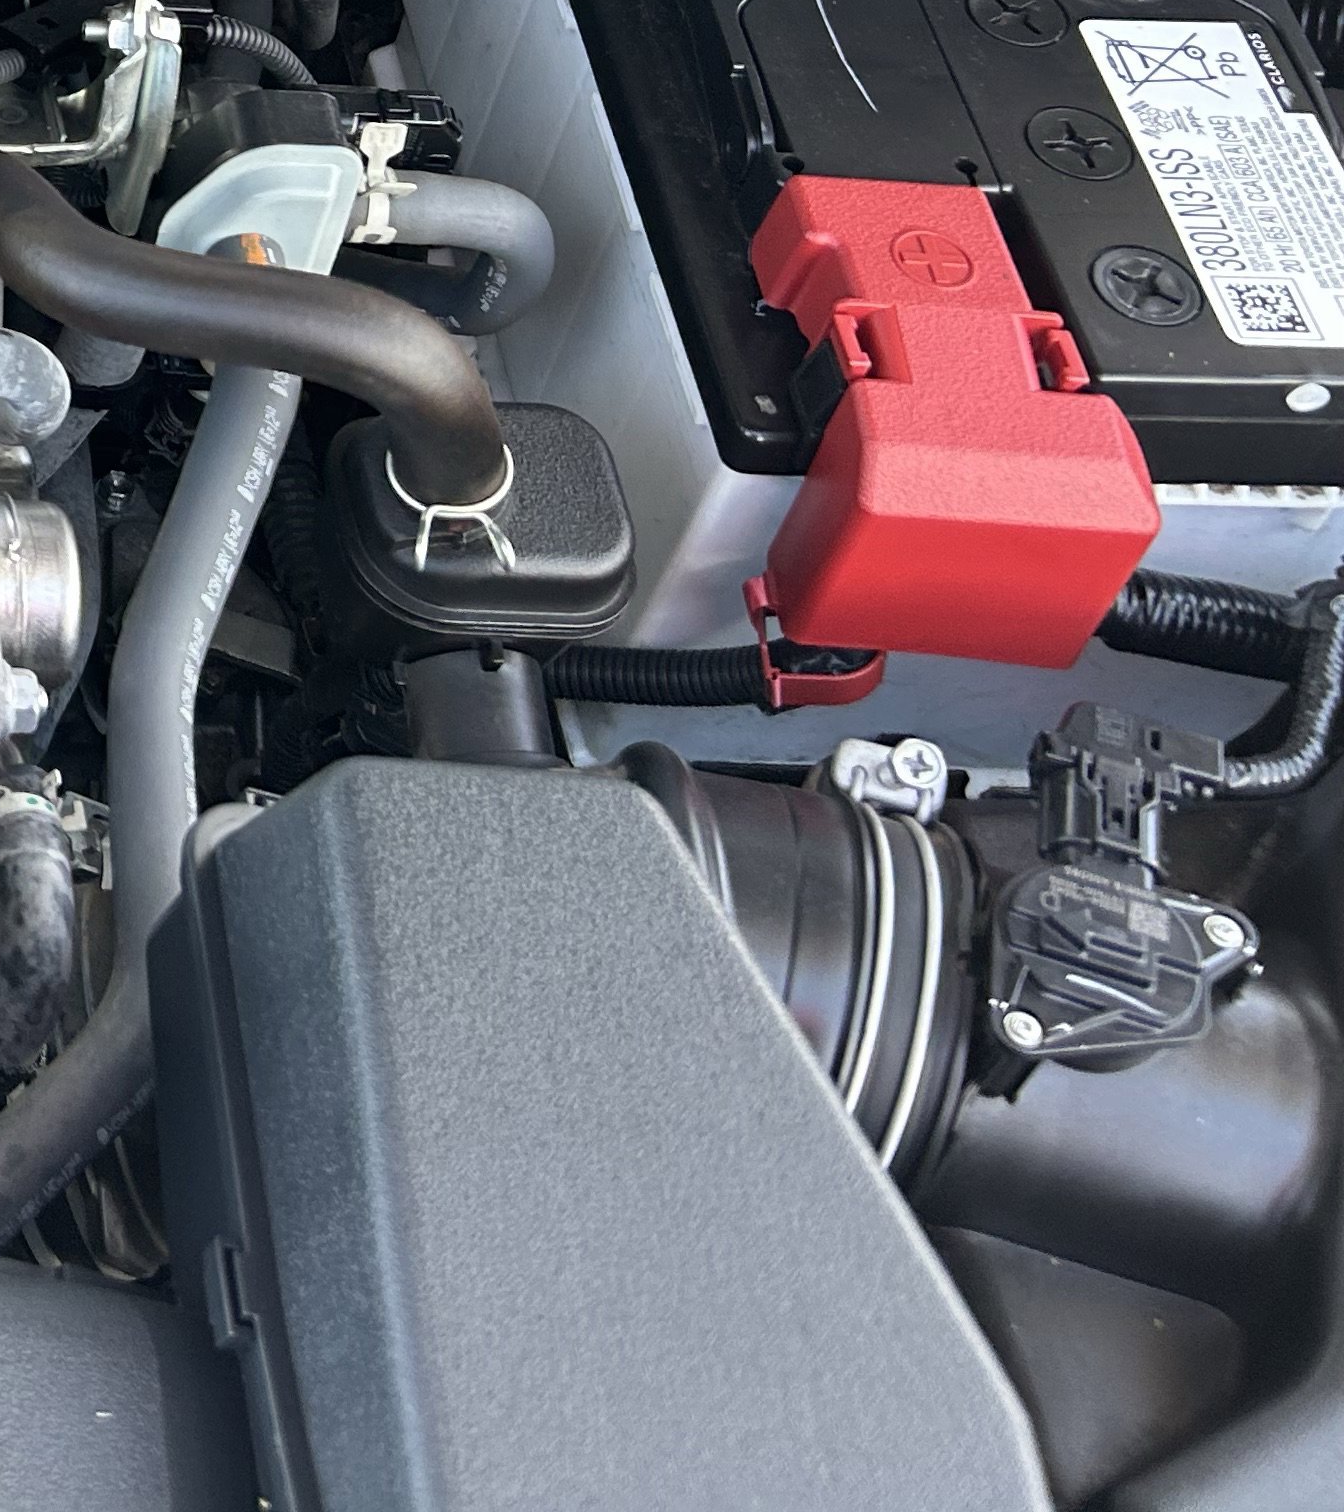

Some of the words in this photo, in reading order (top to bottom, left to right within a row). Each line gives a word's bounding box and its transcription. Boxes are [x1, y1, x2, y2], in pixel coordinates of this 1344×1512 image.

[1211, 51, 1248, 76] Pb
[1247, 33, 1286, 86] CLARIOS
[1205, 115, 1244, 142] (SAE)
[1221, 145, 1245, 153] A
[1227, 157, 1257, 175] 603
[1238, 180, 1270, 201] CCA
[1144, 148, 1250, 270] 380LN3-ISS
[1252, 209, 1279, 222] Ah
[1261, 226, 1289, 239] 65
[1270, 244, 1296, 255] Hr
[1277, 259, 1306, 272] 20
